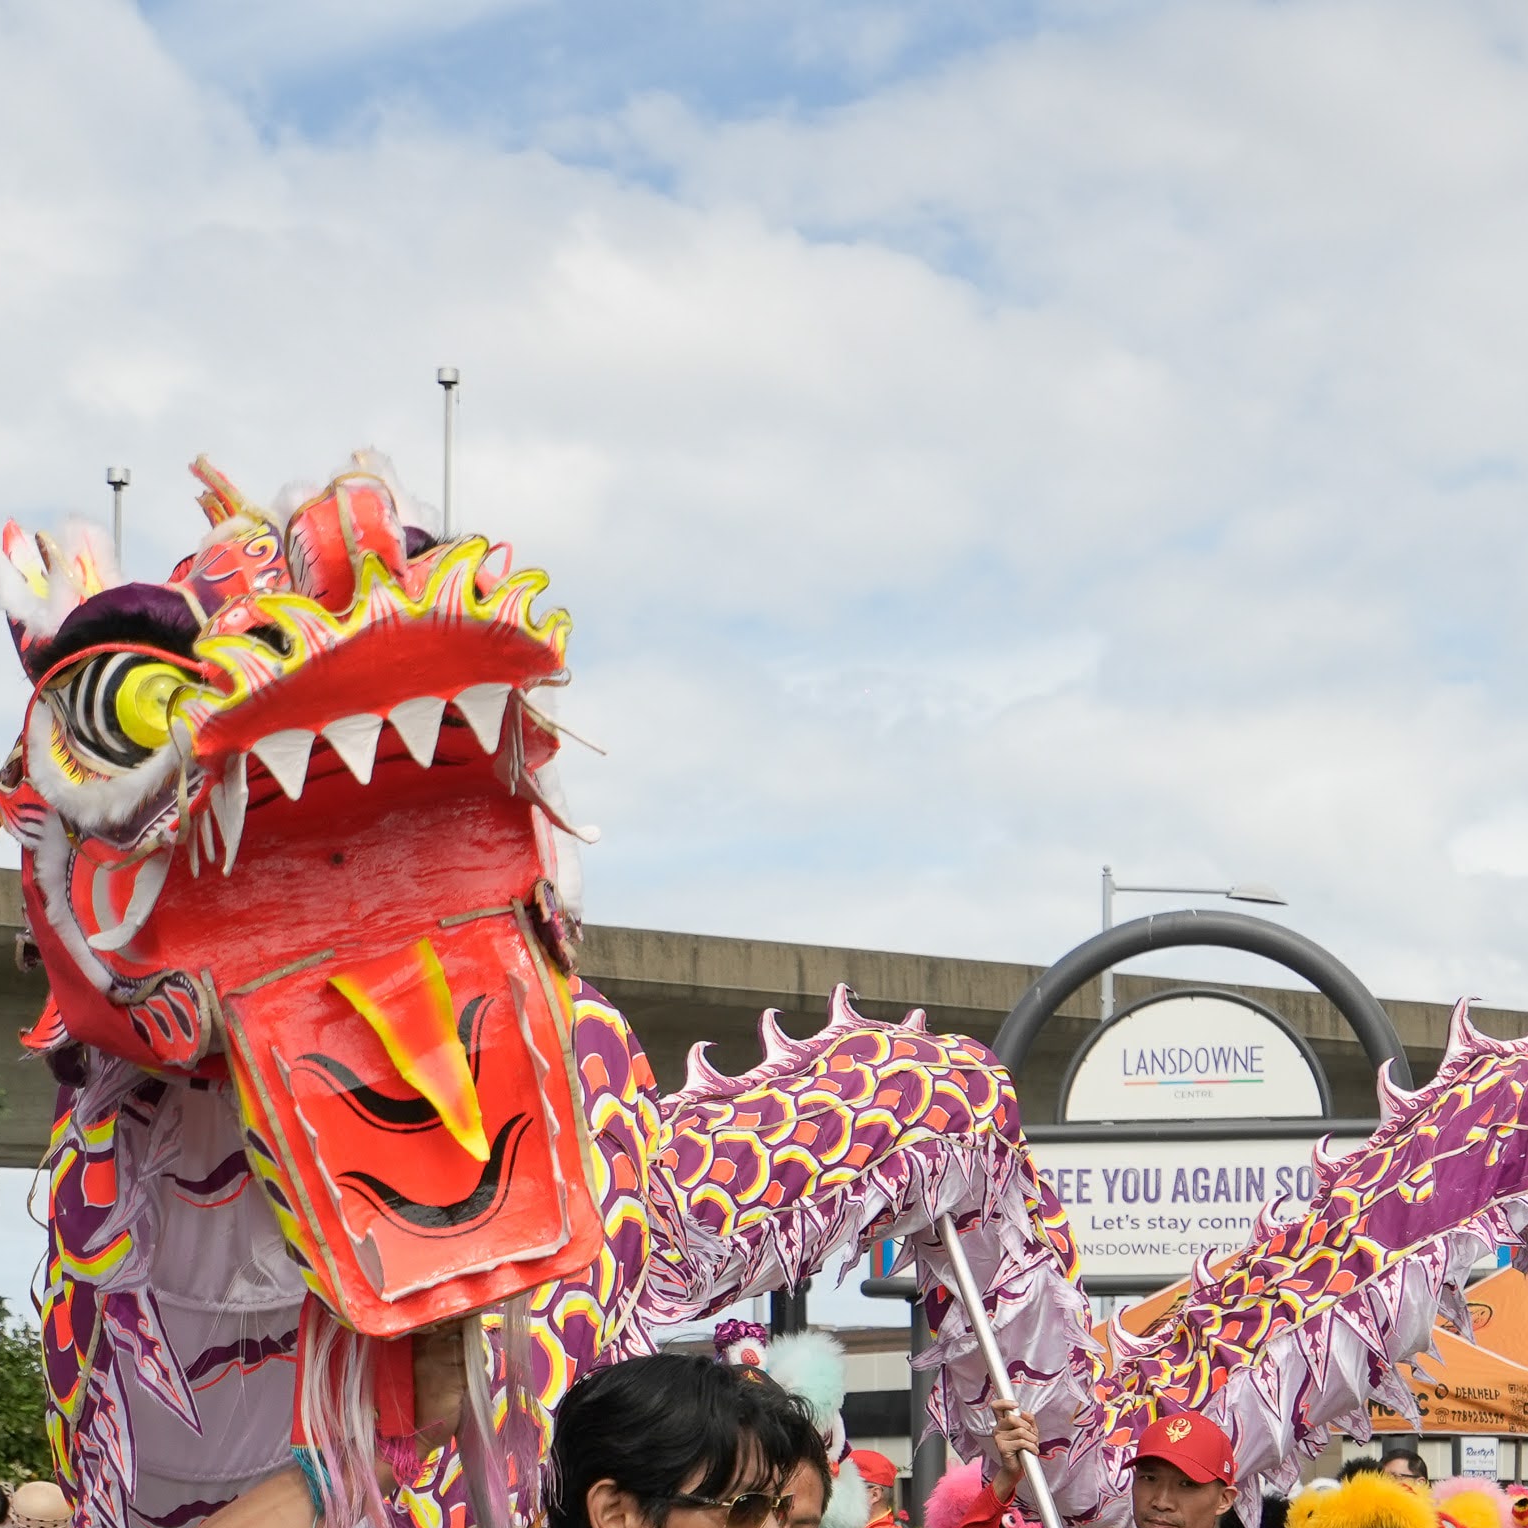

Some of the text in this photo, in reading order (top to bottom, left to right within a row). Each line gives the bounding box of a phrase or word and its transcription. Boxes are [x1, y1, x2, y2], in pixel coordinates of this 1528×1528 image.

[1123, 1046, 1264, 1076] LANSDOWNE
[1174, 1090, 1213, 1099] CENTRE
[1102, 1167, 1161, 1204] YOU
[1171, 1166, 1265, 1203] AGAIN
[1091, 1214, 1140, 1230] Let's
[1147, 1215, 1191, 1233] stay
[1455, 1387, 1501, 1400] DEALHELP
